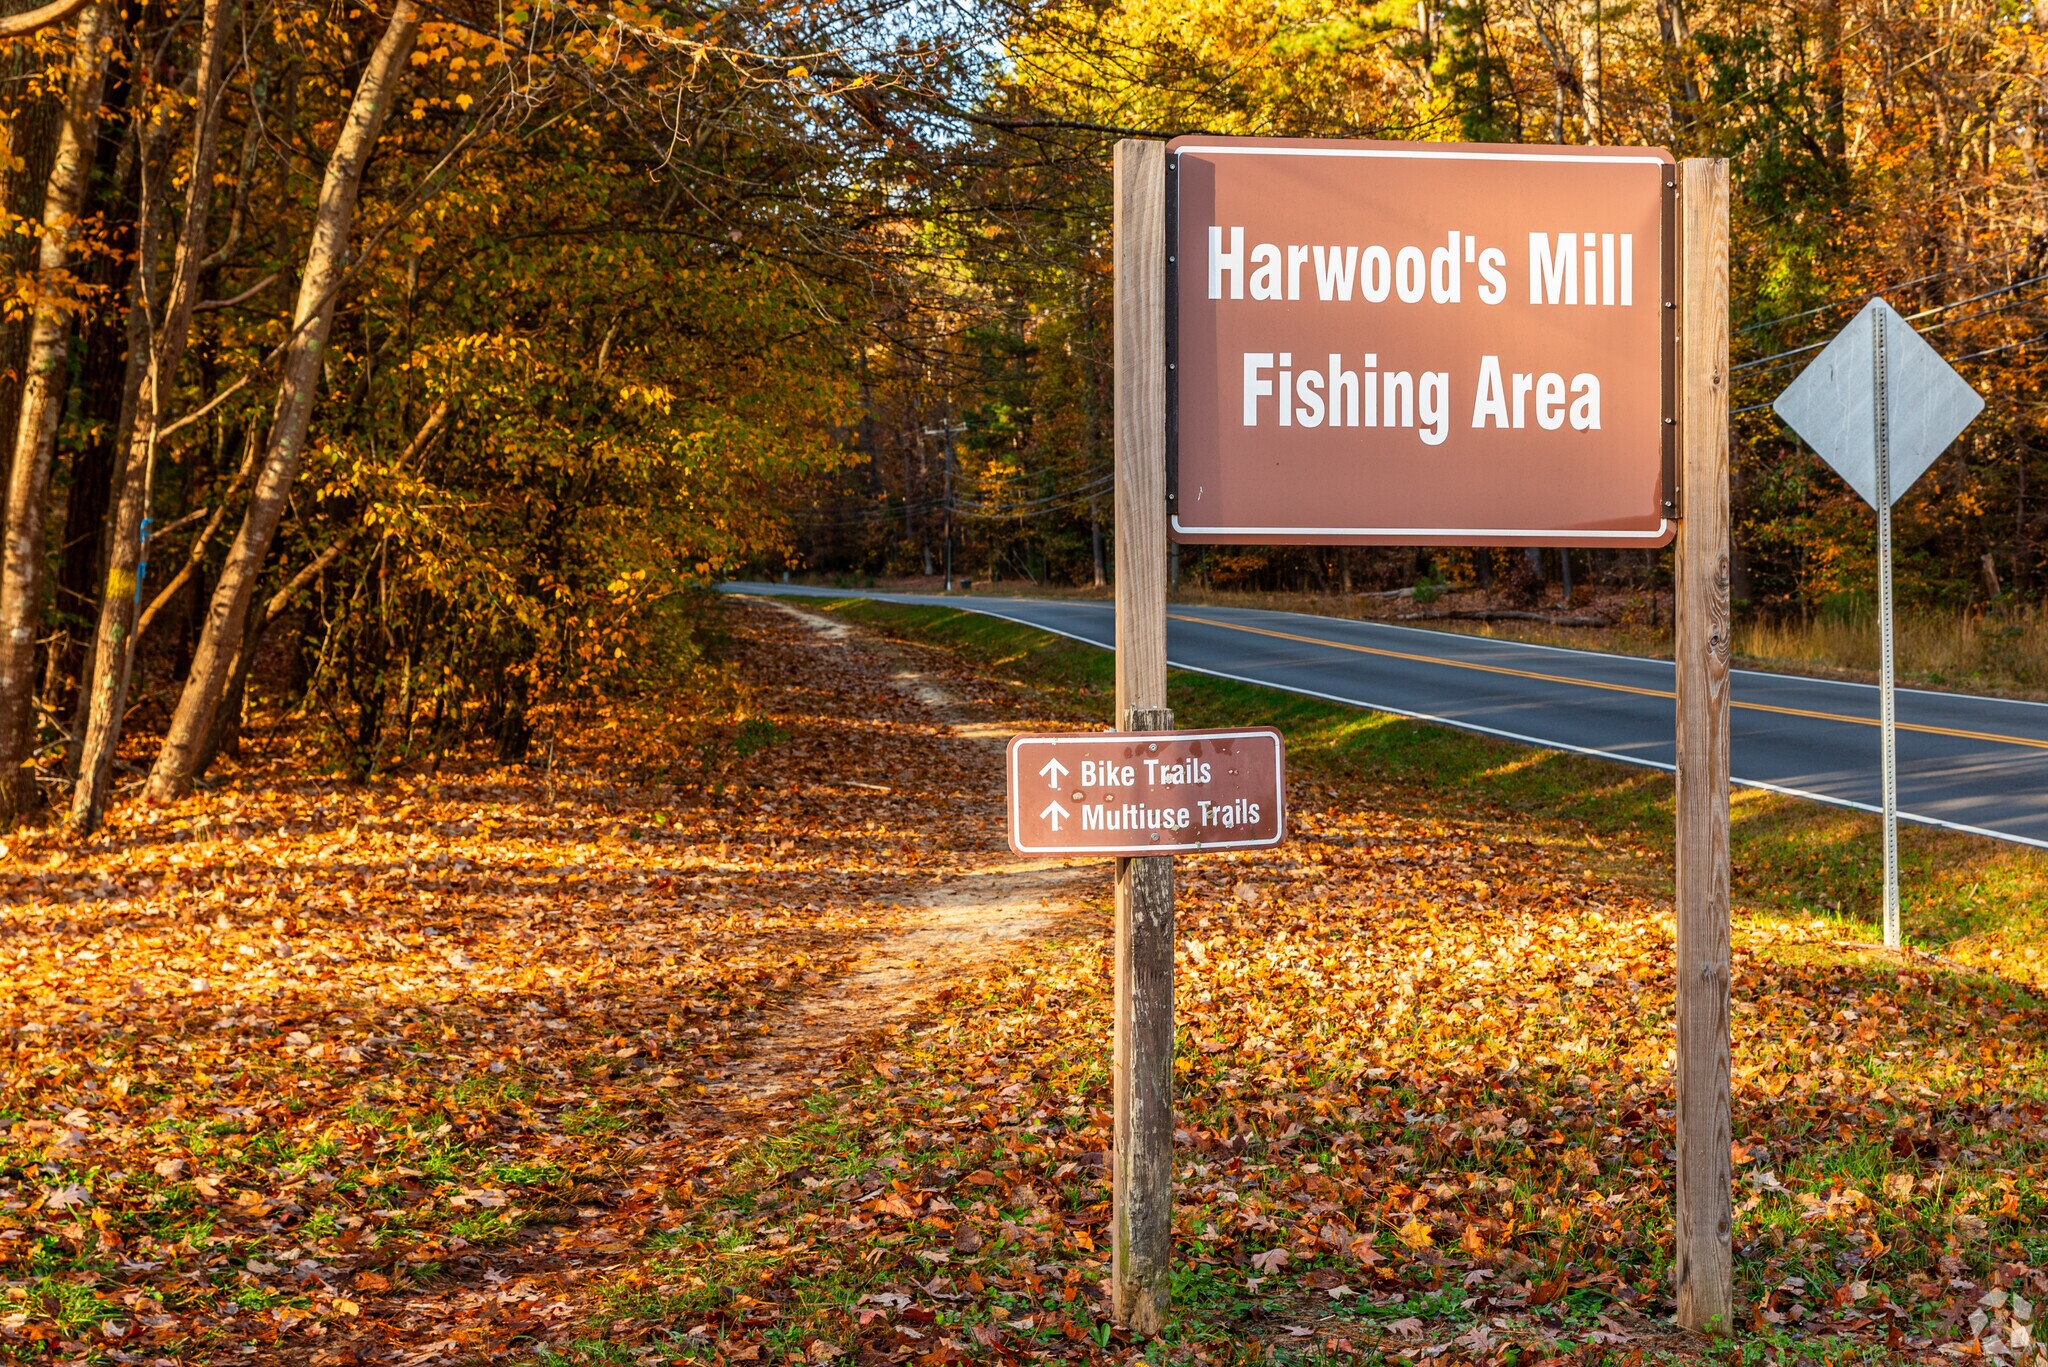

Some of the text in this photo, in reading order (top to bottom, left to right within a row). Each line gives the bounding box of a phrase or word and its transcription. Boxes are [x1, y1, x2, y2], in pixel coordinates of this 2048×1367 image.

[1206, 225, 1634, 307] Harwood's Mill
[1242, 352, 1602, 446] Fishing Area
[1081, 758, 1212, 787] Bike Trails
[1081, 798, 1261, 831] Multiuse Trails
